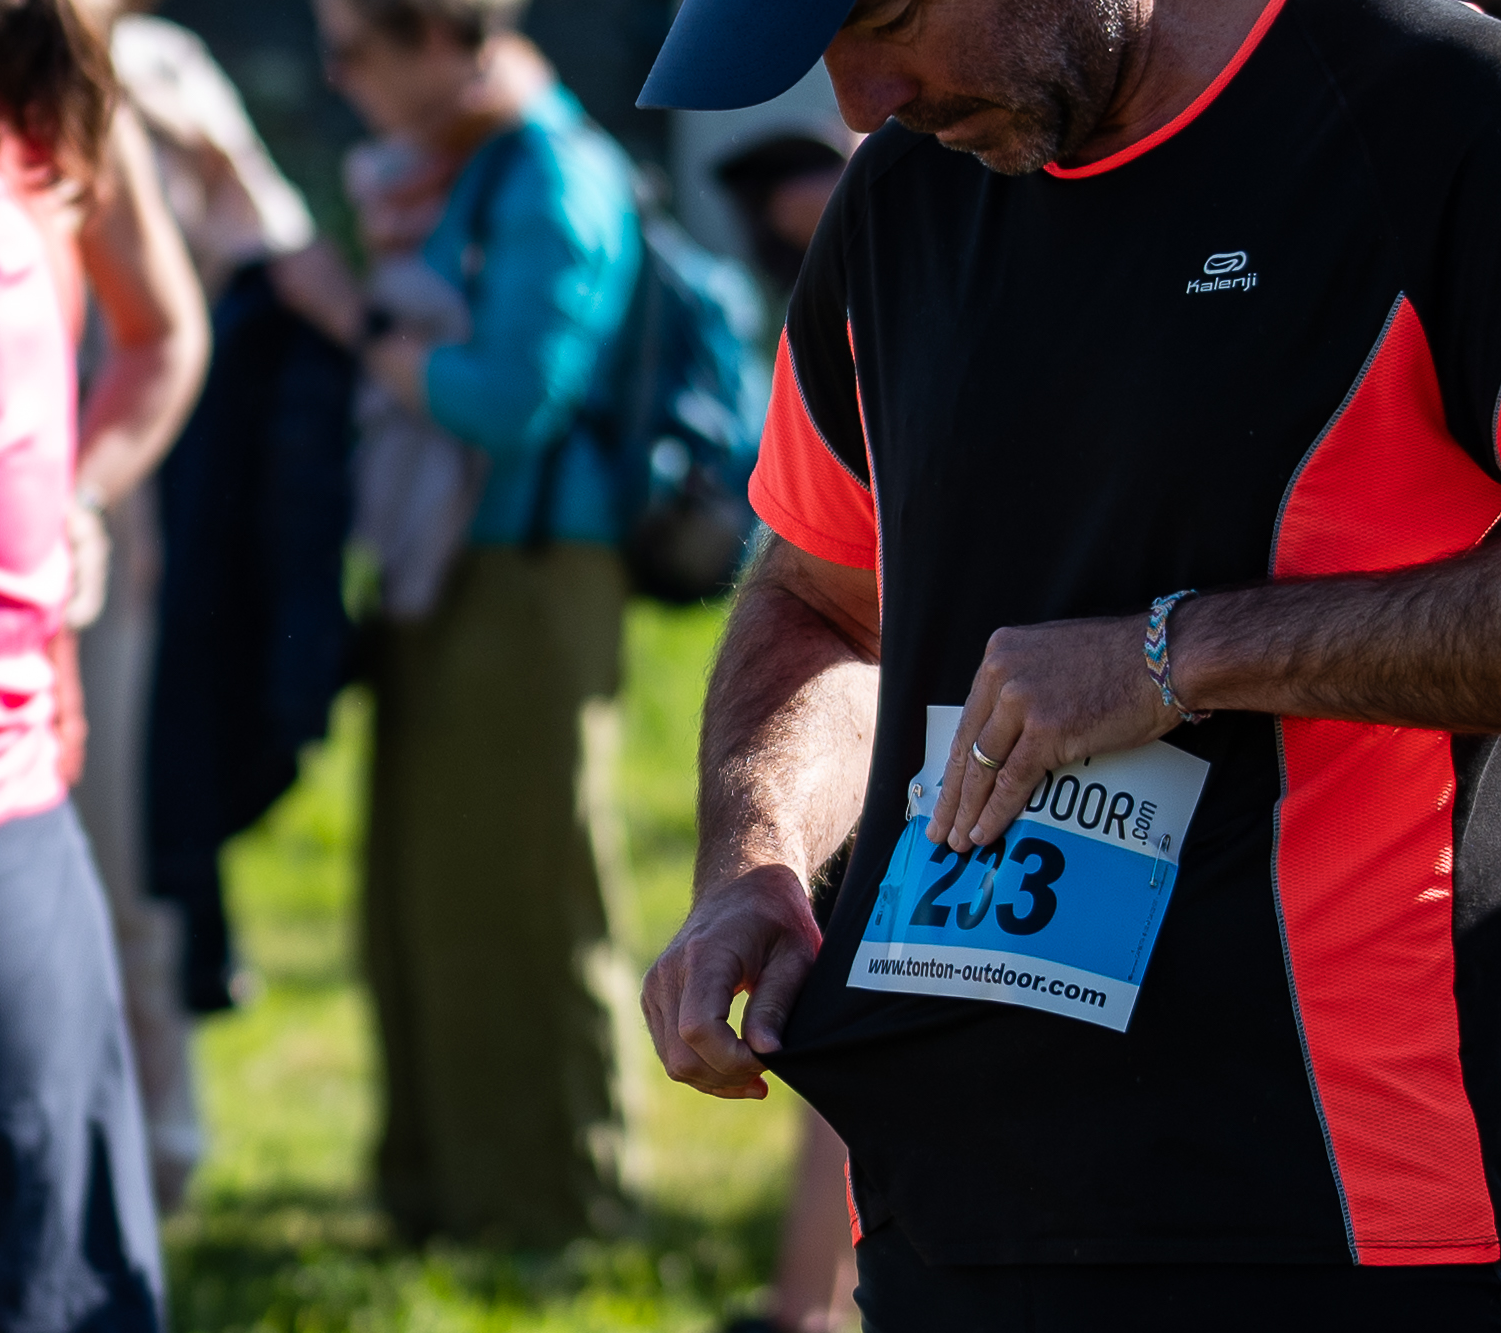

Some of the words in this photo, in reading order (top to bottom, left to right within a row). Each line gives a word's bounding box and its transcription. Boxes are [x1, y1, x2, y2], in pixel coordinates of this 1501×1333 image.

[1186, 272, 1257, 294] Kalenji
[1025, 769, 1135, 841] DOOR
[1131, 799, 1158, 846] .com
[867, 955, 1108, 1009] www.tonton-outdoor.com
